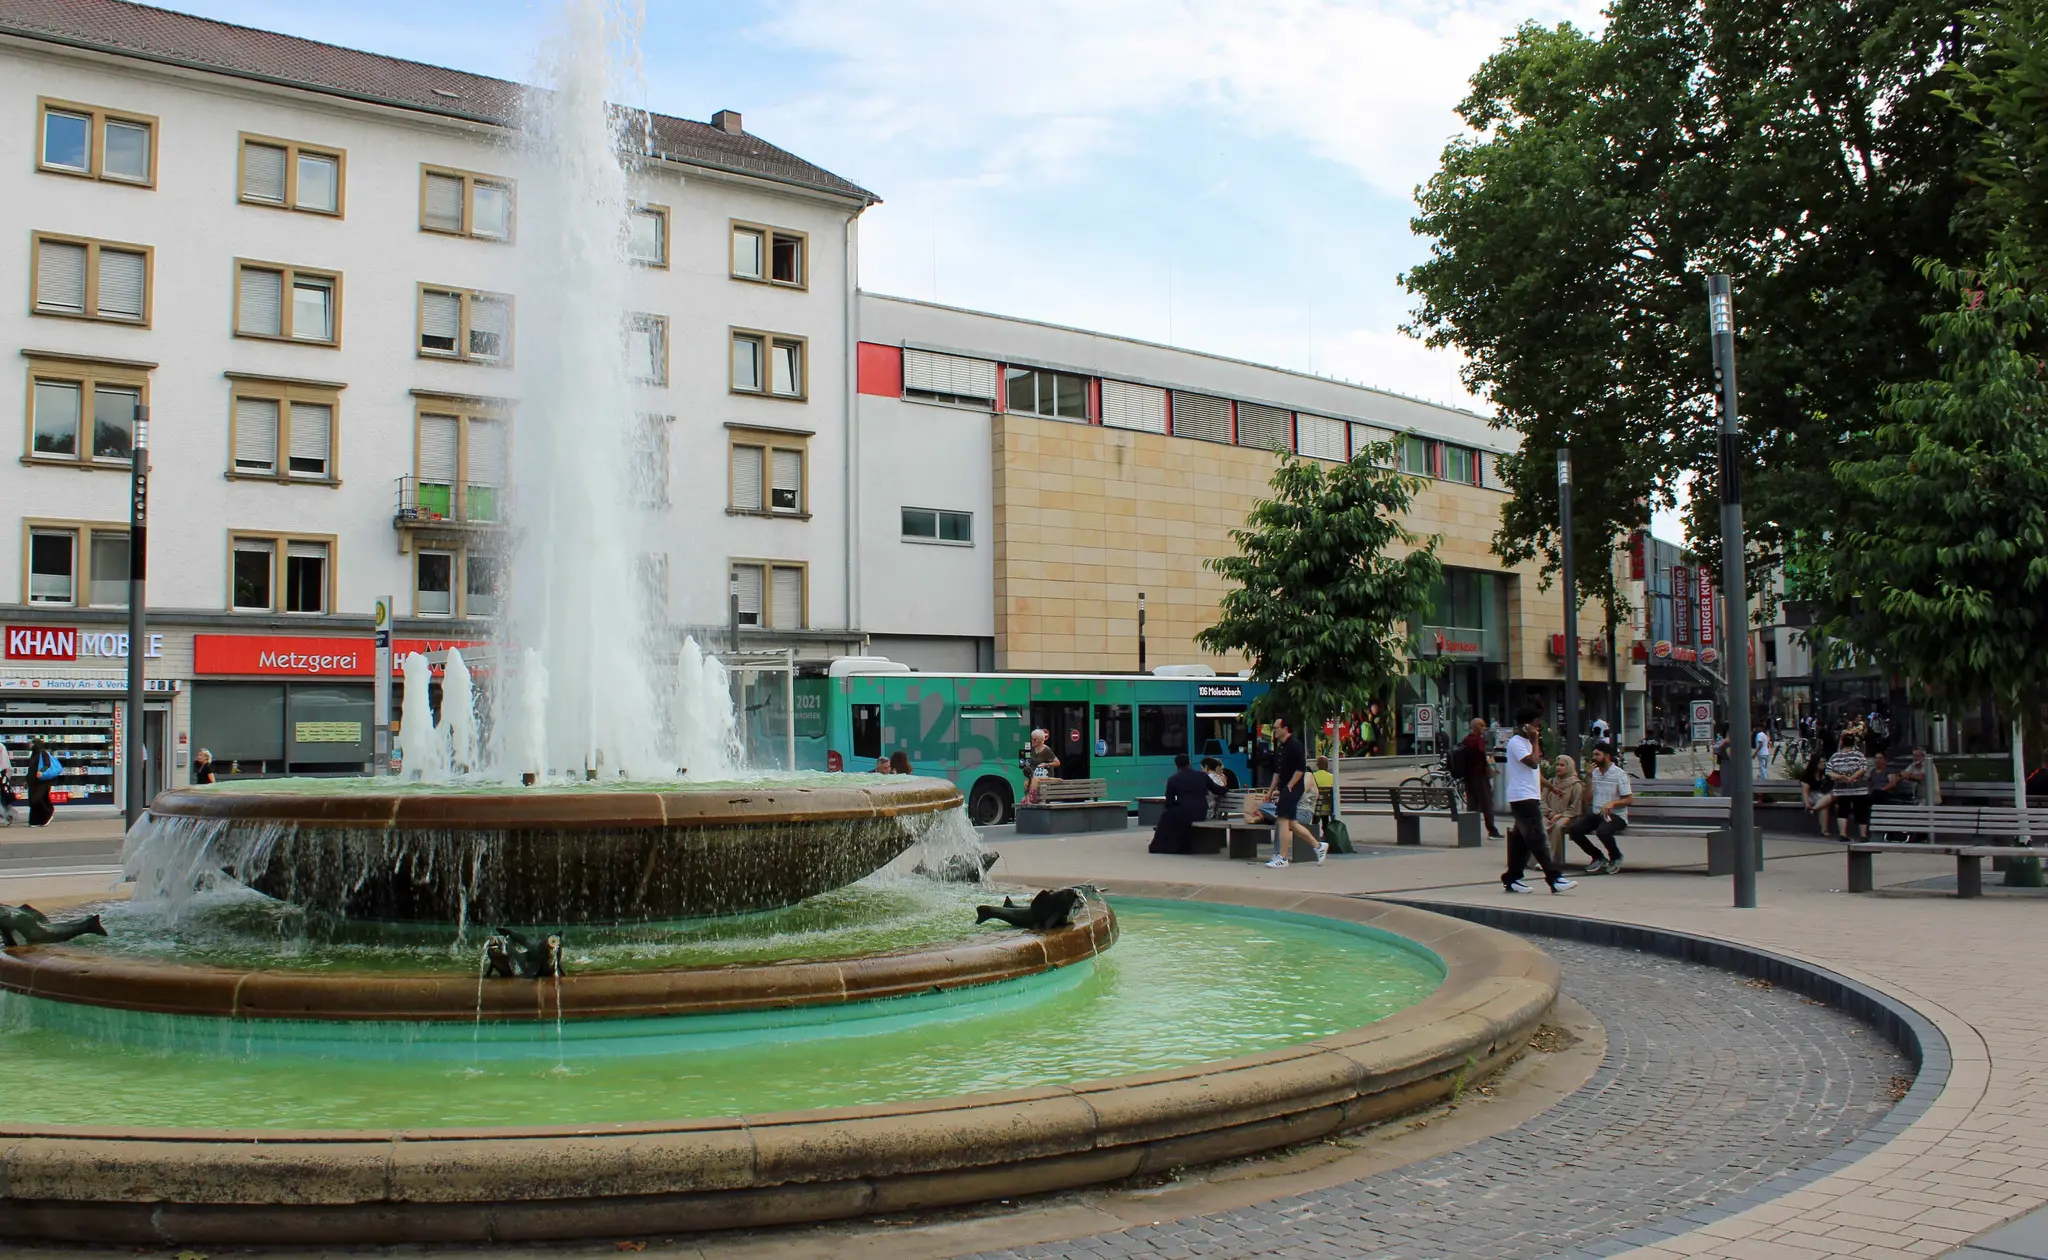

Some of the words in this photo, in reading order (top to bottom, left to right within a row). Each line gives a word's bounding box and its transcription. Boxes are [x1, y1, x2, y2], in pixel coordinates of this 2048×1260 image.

[1700, 568, 1710, 595] KING
[1701, 598, 1711, 640] BURGER
[10, 630, 74, 656] KHAN
[82, 633, 163, 658] MOBE
[259, 651, 357, 673] Metzgerei
[47, 680, 75, 689] Handy
[78, 680, 94, 688] An-
[97, 680, 103, 688] &
[106, 680, 129, 688] Verka
[1199, 686, 1208, 696] 106
[796, 694, 821, 709] 2021
